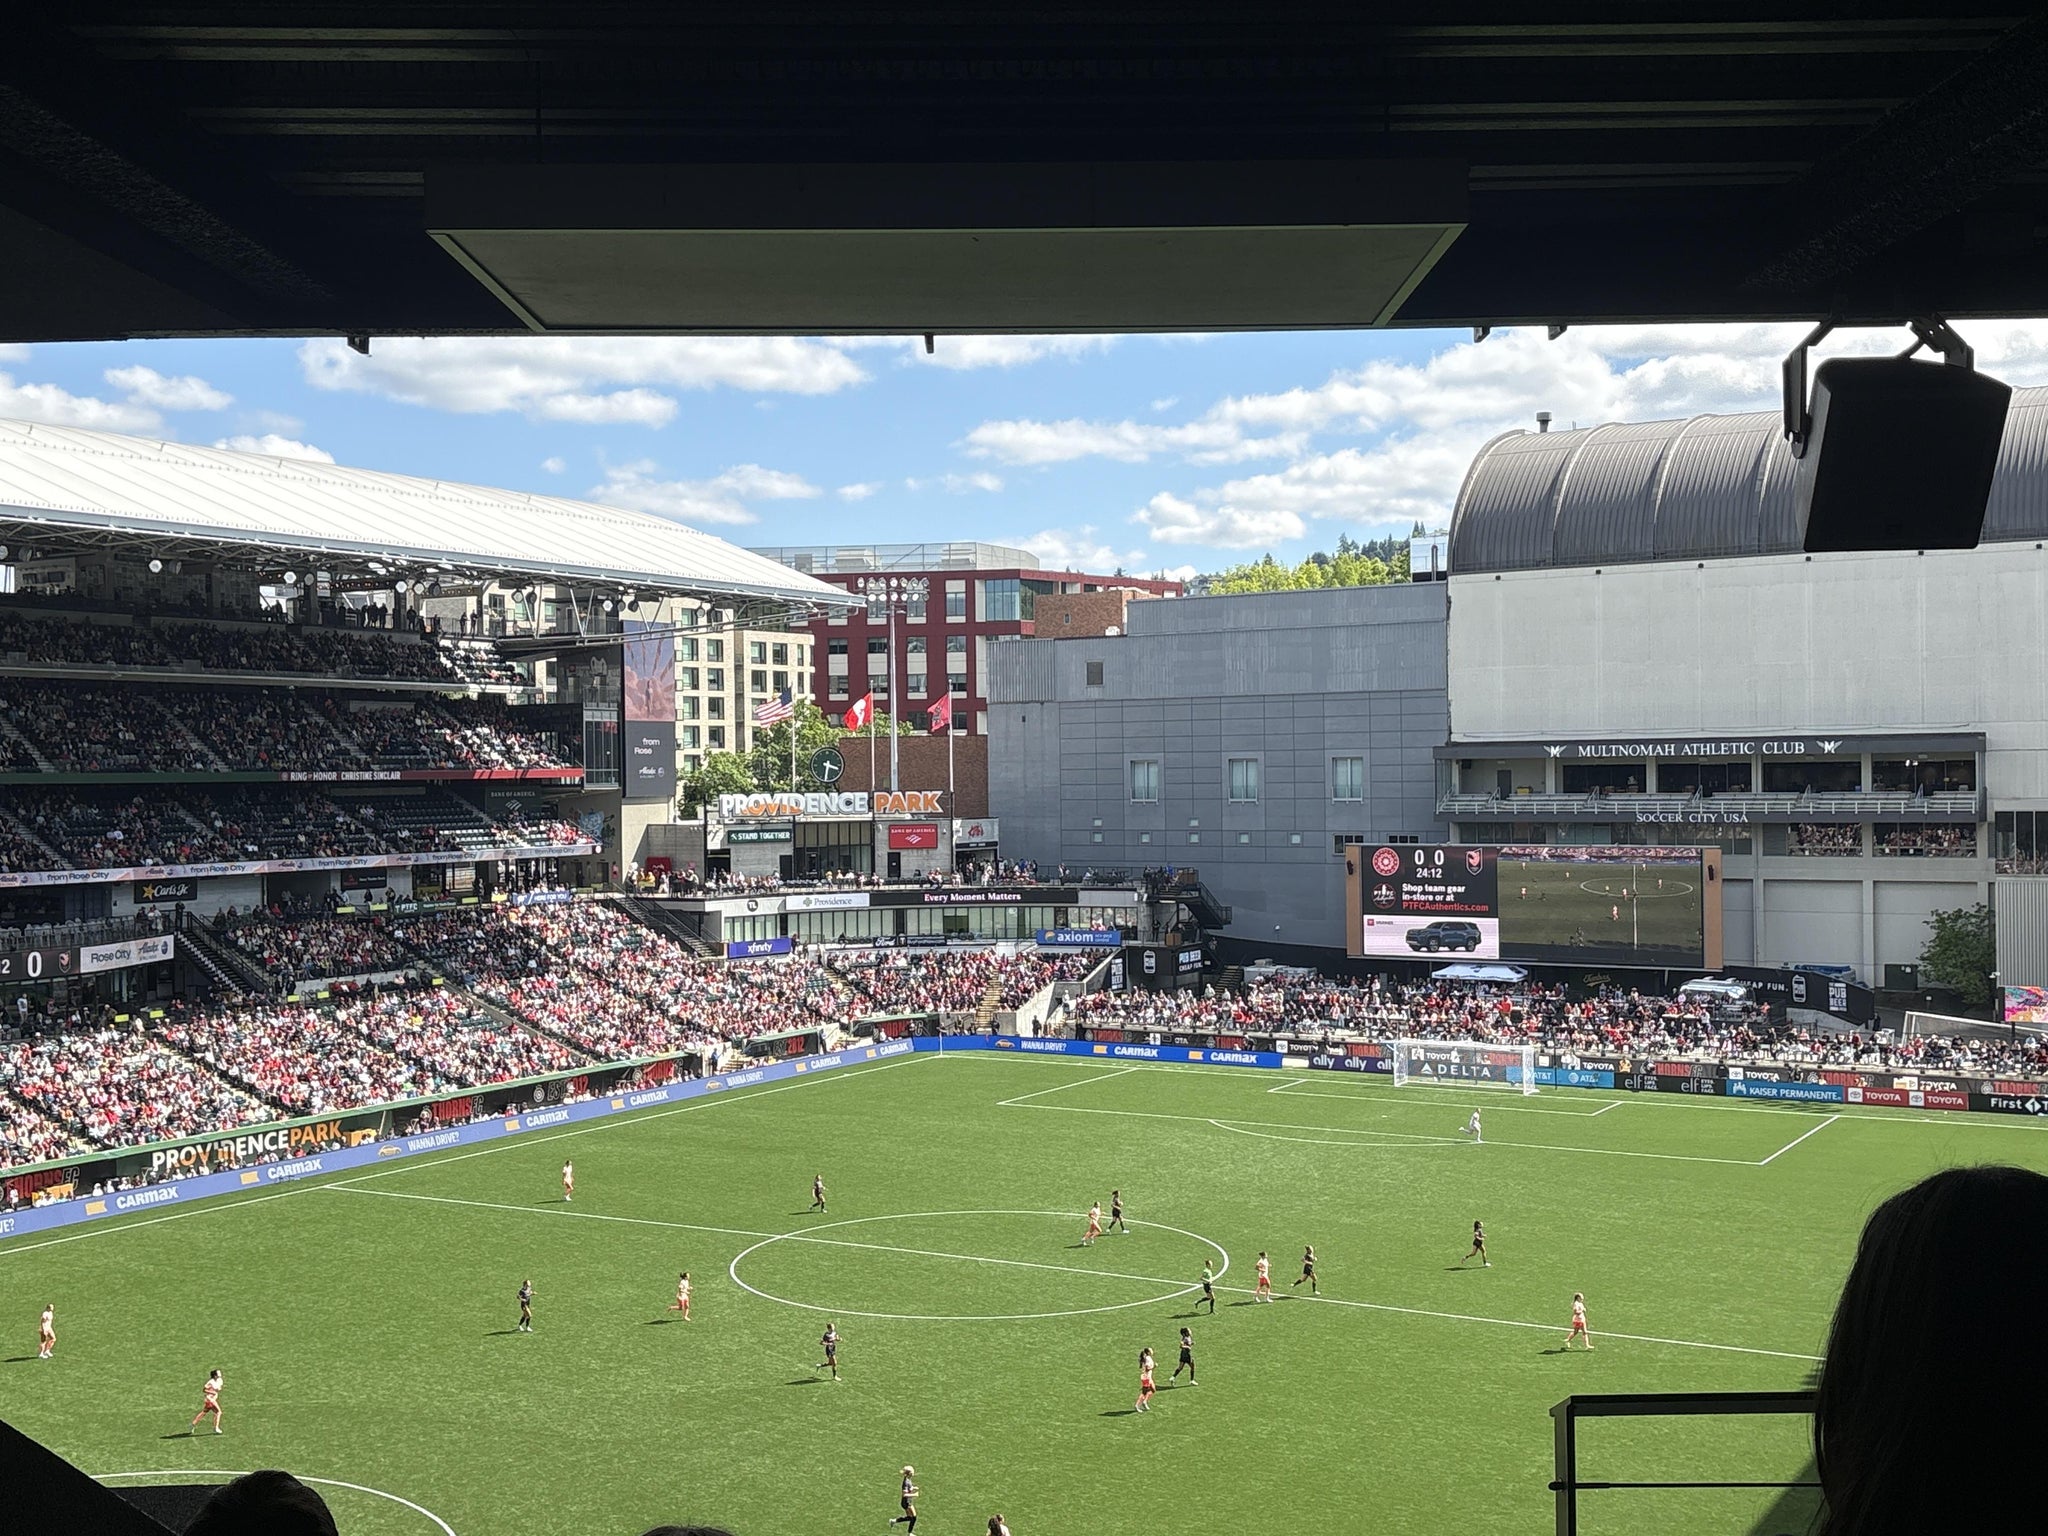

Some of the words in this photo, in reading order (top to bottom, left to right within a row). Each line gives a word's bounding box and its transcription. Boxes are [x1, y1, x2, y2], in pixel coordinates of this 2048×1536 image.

[1578, 743, 1676, 758] MULTNOMAH
[1680, 742, 1755, 756] ATHLETIC
[1763, 741, 1805, 754] CLUB
[290, 771, 307, 781] RING
[313, 771, 338, 781] HONOR
[719, 792, 869, 818] PROVIDENCE
[873, 790, 944, 815] PARK
[1636, 813, 1684, 823] SOCCER
[1688, 813, 1719, 823] CITY
[1723, 813, 1748, 823] USA
[737, 832, 758, 840] STAND
[760, 831, 790, 839] TOGETHER
[353, 858, 368, 866] City
[1414, 849, 1424, 865] 0
[1434, 849, 1445, 865] 0
[190, 866, 209, 874] from
[229, 864, 246, 872] City
[1416, 867, 1442, 878] 24:12
[46, 873, 68, 882] from
[91, 871, 109, 880] City
[1402, 883, 1424, 894] Shop
[1424, 884, 1446, 892] team
[1447, 885, 1466, 894] gear
[813, 896, 853, 906] Providence
[924, 893, 948, 903] Every
[950, 892, 985, 902] Moment
[987, 892, 1021, 901] Matters
[1402, 893, 1433, 901] in-store
[1445, 893, 1455, 901] at
[1402, 902, 1489, 912] PTFCAuthentics.com
[1057, 930, 1094, 942] axiom
[747, 942, 773, 954] xfinity
[90, 951, 114, 964] Rose
[114, 948, 132, 961] City
[27, 951, 42, 978] 0
[1829, 986, 1847, 999] PUB
[1020, 1039, 1044, 1051] WANNA
[1044, 1041, 1067, 1052] DRIVE?
[1313, 1054, 1335, 1069] ally
[1344, 1056, 1367, 1071] ally
[1425, 1052, 1451, 1061] TOYOT
[1437, 1063, 1491, 1078] DELTA
[1582, 1062, 1615, 1071] TOYOTA
[1624, 1074, 1643, 1090] elf
[1745, 1071, 1780, 1081] TOYOTA
[1681, 1077, 1700, 1093] elf
[1993, 1081, 2039, 1095] THORNS
[1749, 1086, 1778, 1098] KAISER
[1865, 1091, 1902, 1102] TOYOTA
[1927, 1095, 1964, 1105] TOYOTA
[1990, 1097, 2023, 1110] First
[432, 1096, 472, 1121] THORNS
[290, 1119, 344, 1147] PARK
[407, 1135, 437, 1151] WANNA
[436, 1131, 461, 1146] DRIVE?
